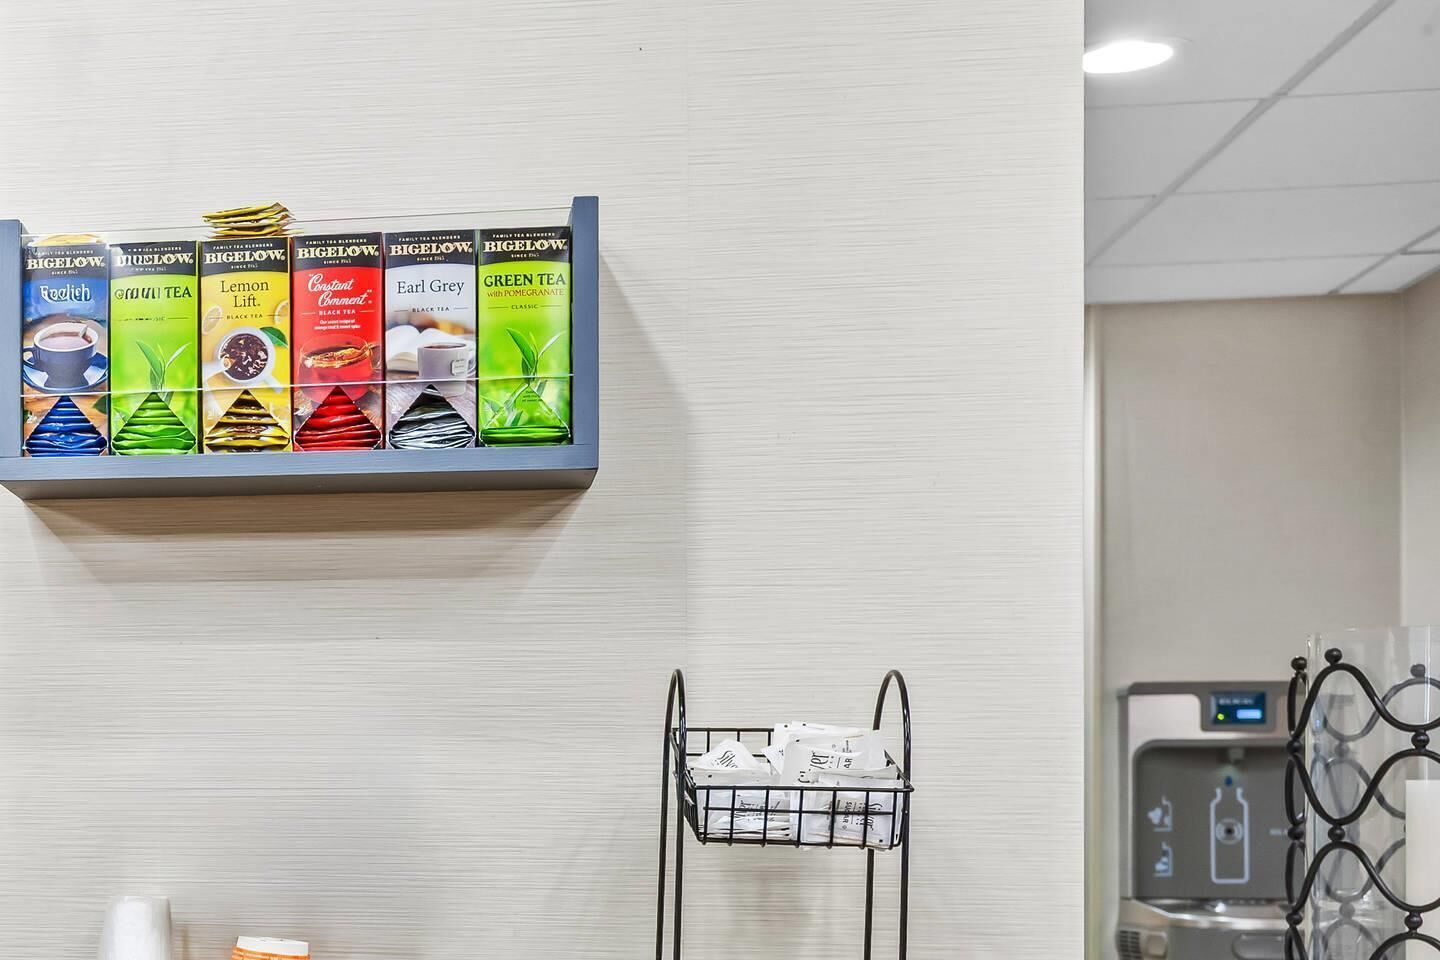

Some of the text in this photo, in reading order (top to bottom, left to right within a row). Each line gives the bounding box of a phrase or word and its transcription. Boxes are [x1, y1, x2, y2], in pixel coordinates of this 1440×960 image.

[220, 280, 269, 293] Lemon
[484, 273, 566, 288] GREEN TEA
[164, 286, 192, 298] TEA
[397, 279, 464, 296] Earl Grey
[488, 288, 564, 298] with POMEGRANATE
